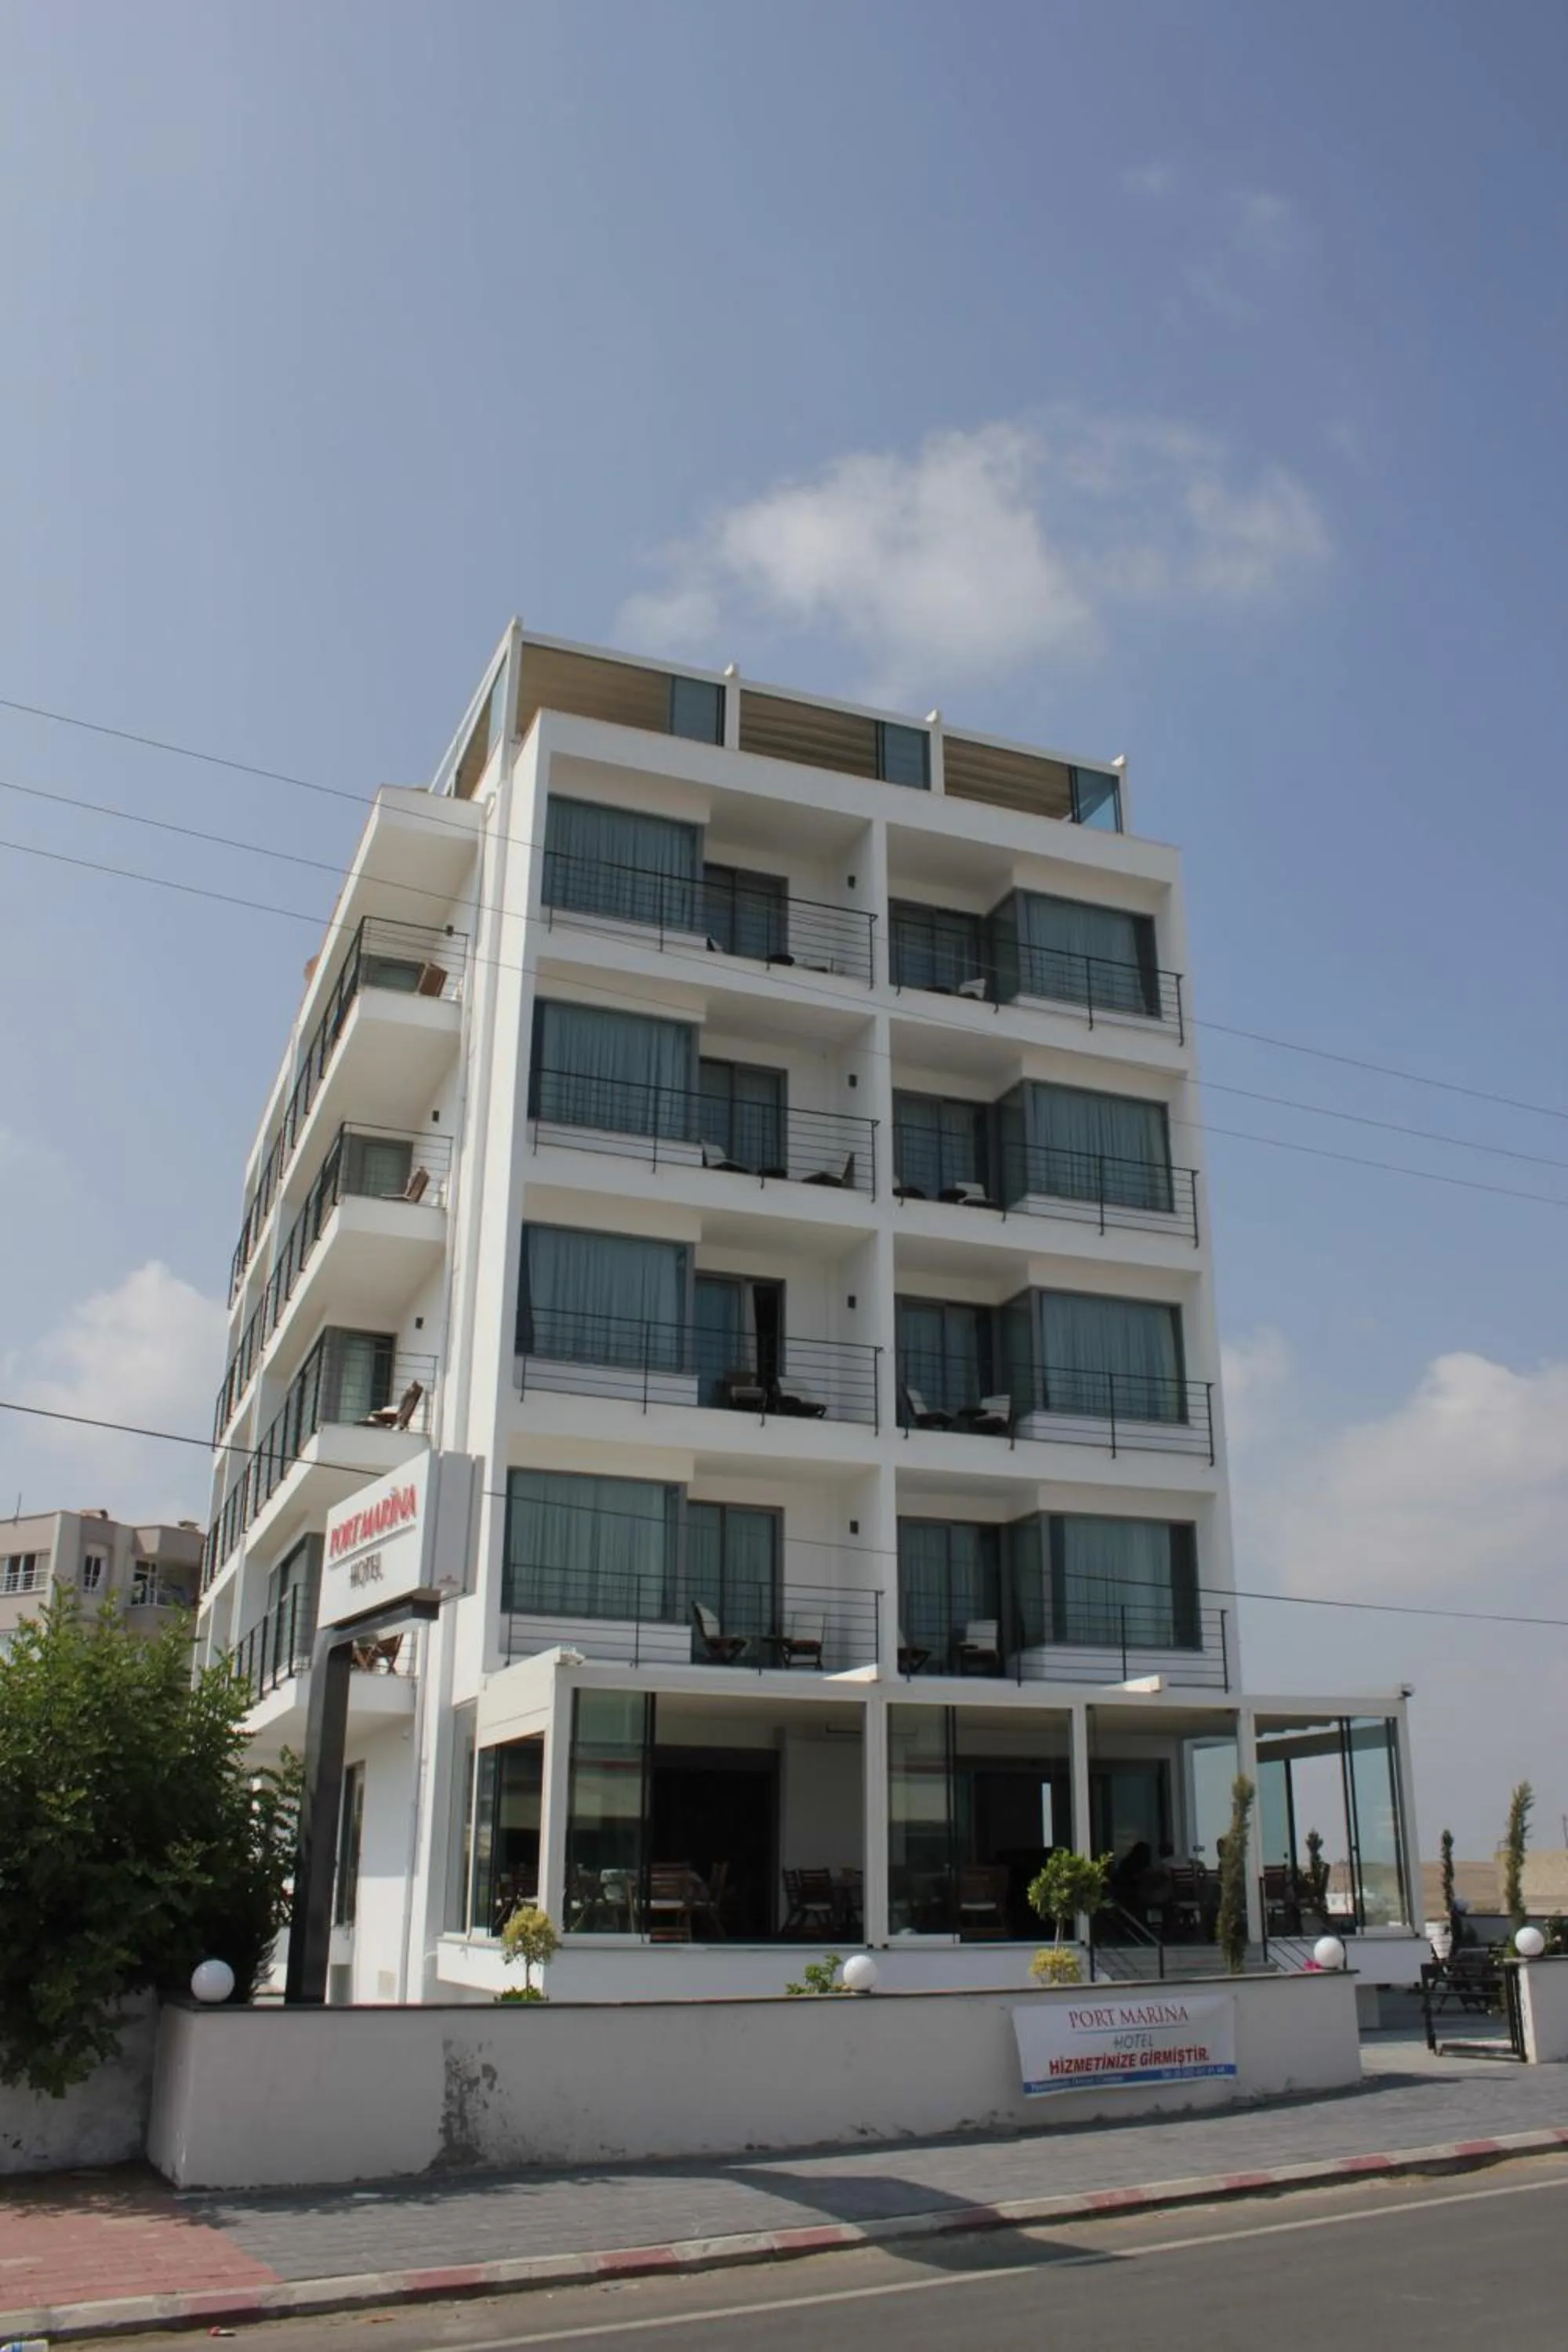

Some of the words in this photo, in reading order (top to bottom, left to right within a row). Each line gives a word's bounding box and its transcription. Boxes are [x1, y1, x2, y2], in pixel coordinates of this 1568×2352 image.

[329, 1512, 363, 1557] PORT
[350, 1552, 383, 1588] HOTEL
[1069, 2008, 1116, 2029] PORT
[1113, 2033, 1153, 2049] HOTEL
